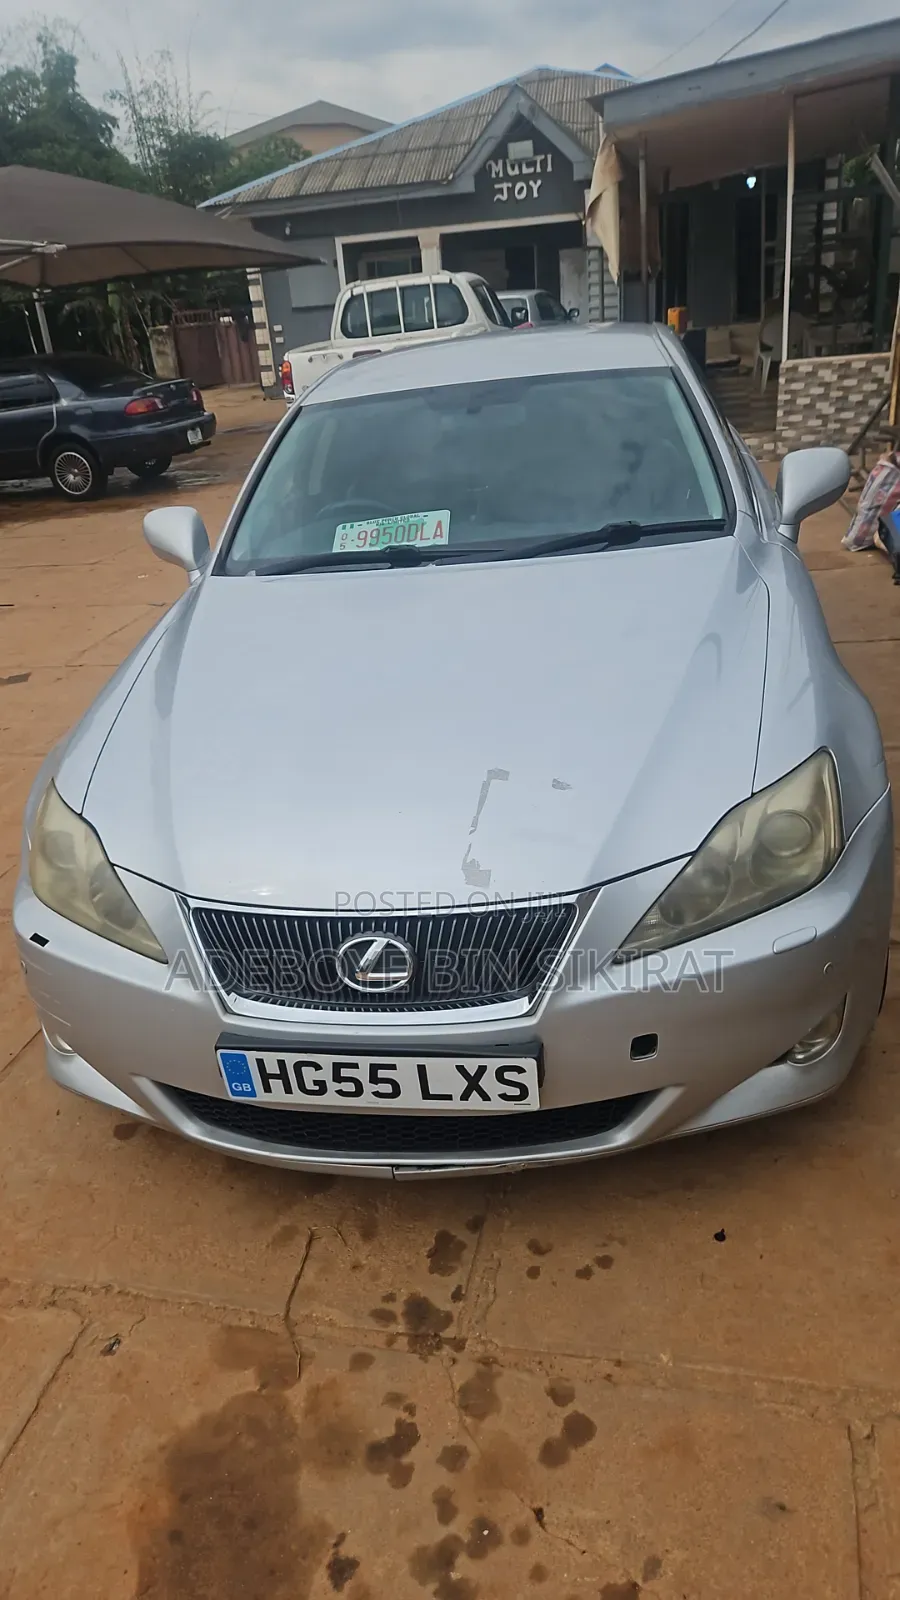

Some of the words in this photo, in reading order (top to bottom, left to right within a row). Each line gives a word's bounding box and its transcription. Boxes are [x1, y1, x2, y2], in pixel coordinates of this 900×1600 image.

[486, 153, 552, 178] MULTI
[493, 179, 542, 202] JOY
[231, 1082, 252, 1093] GB
[255, 1057, 402, 1100] HG55
[416, 1063, 540, 1102] LXS
